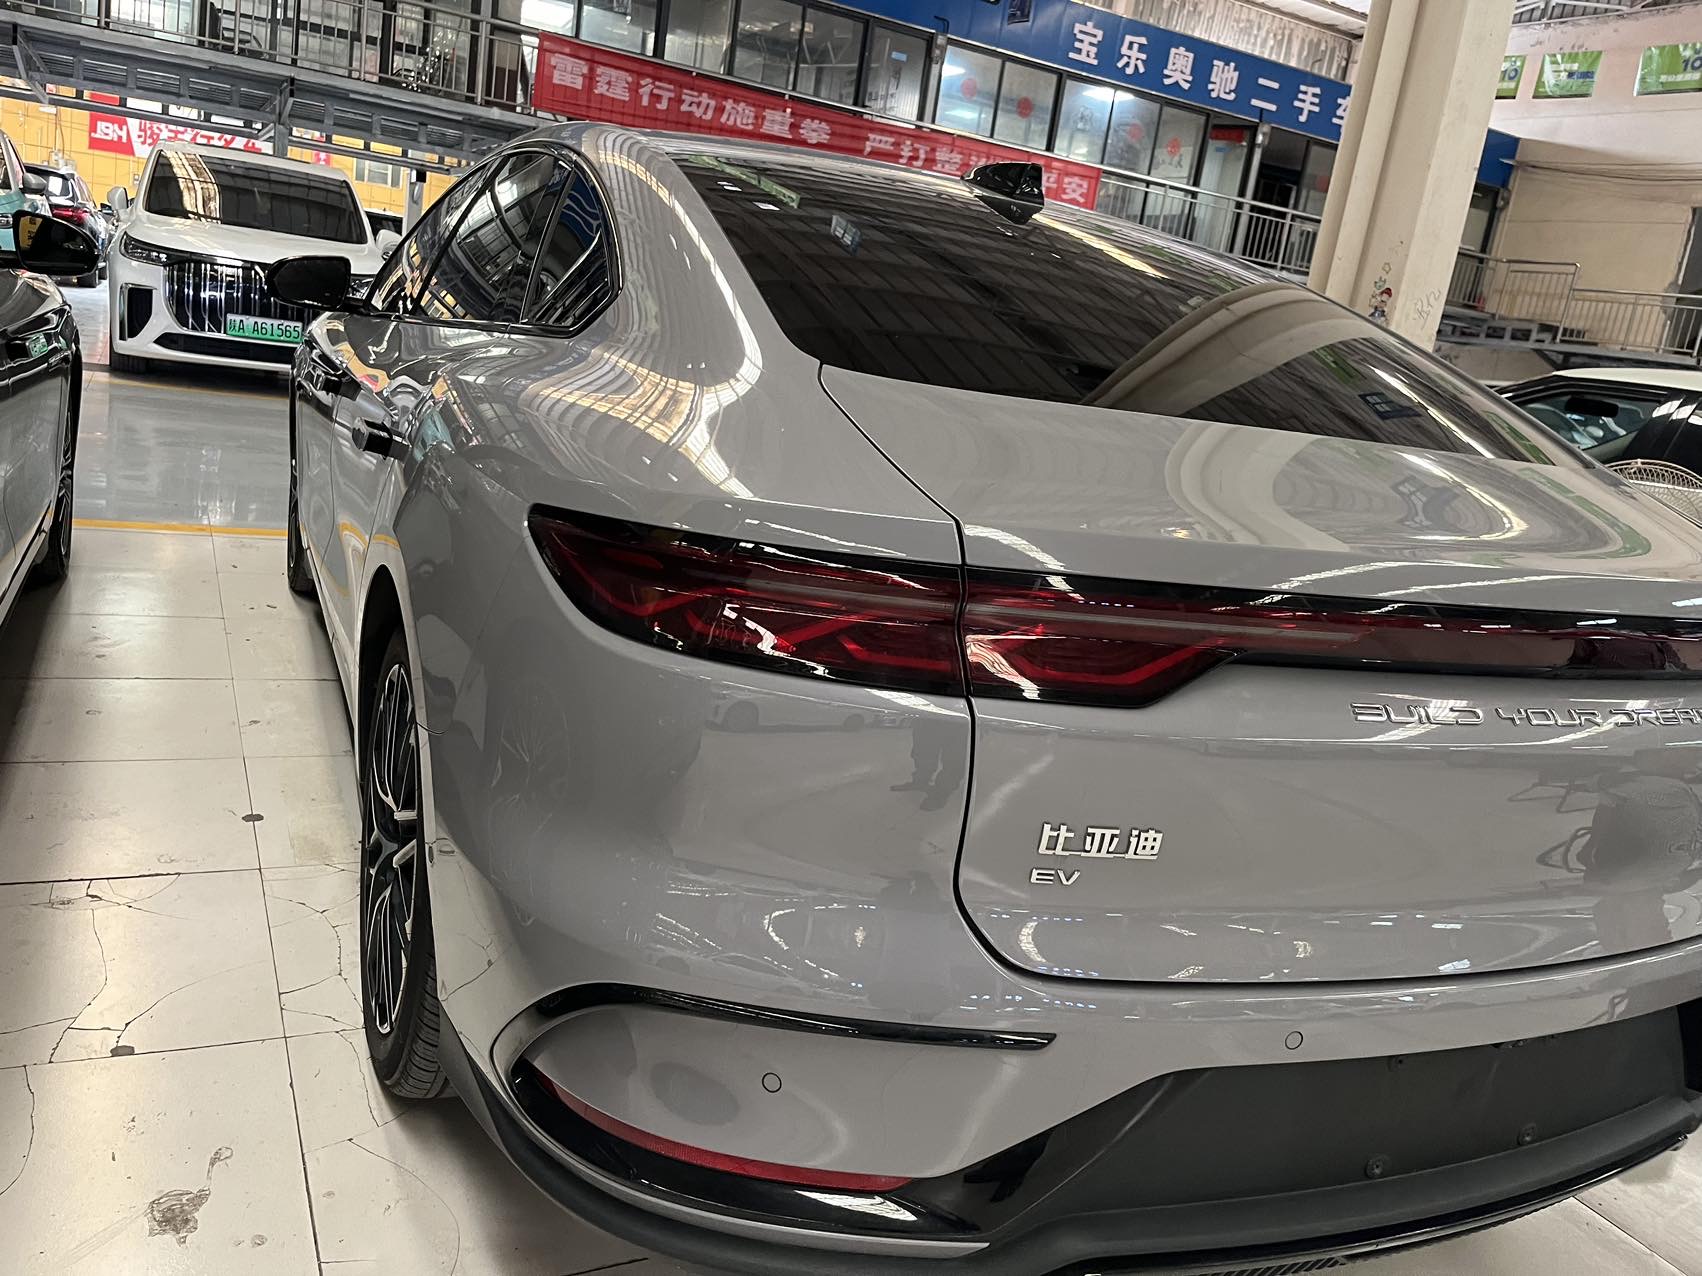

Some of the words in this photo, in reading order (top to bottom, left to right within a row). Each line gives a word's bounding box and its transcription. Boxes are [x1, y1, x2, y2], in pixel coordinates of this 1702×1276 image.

[551, 52, 831, 145] 雷霆行动施重拳
[252, 321, 300, 339] A61565
[1350, 702, 1484, 726] BUILD
[1495, 707, 1604, 727] YOUR
[1038, 822, 1163, 860] 比亚迪
[1030, 868, 1081, 886] EV
